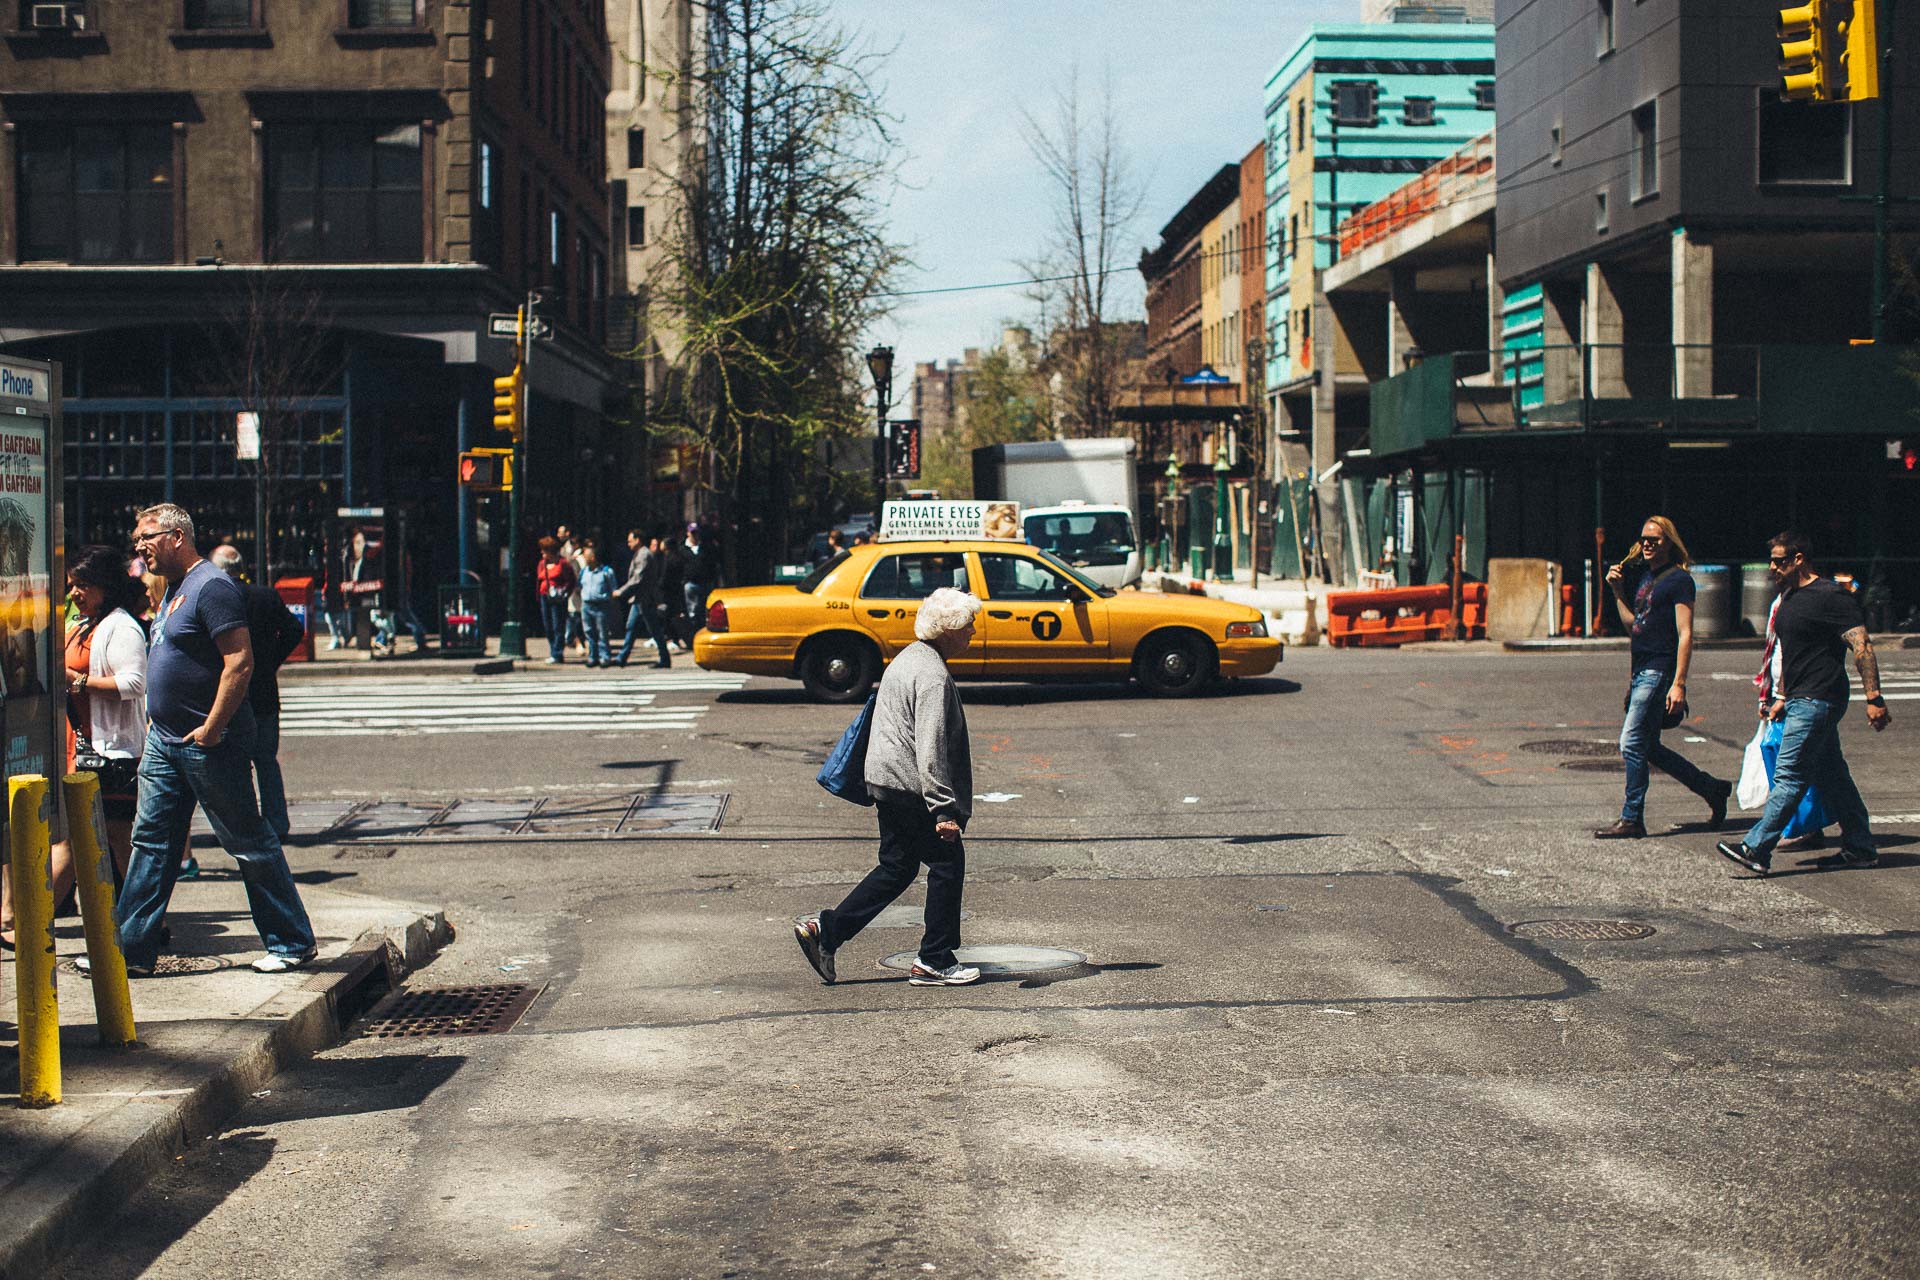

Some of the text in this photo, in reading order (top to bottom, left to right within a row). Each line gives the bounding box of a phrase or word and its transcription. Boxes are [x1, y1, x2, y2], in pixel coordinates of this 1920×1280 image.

[2, 368, 33, 395] Phone
[4, 433, 41, 456] GAFFIGAN
[5, 474, 41, 494] GAFFIGAN
[890, 506, 981, 518] PRIVATE EYES
[888, 520, 980, 528] GENTLEMEN'S CLUB
[1038, 616, 1056, 637] T
